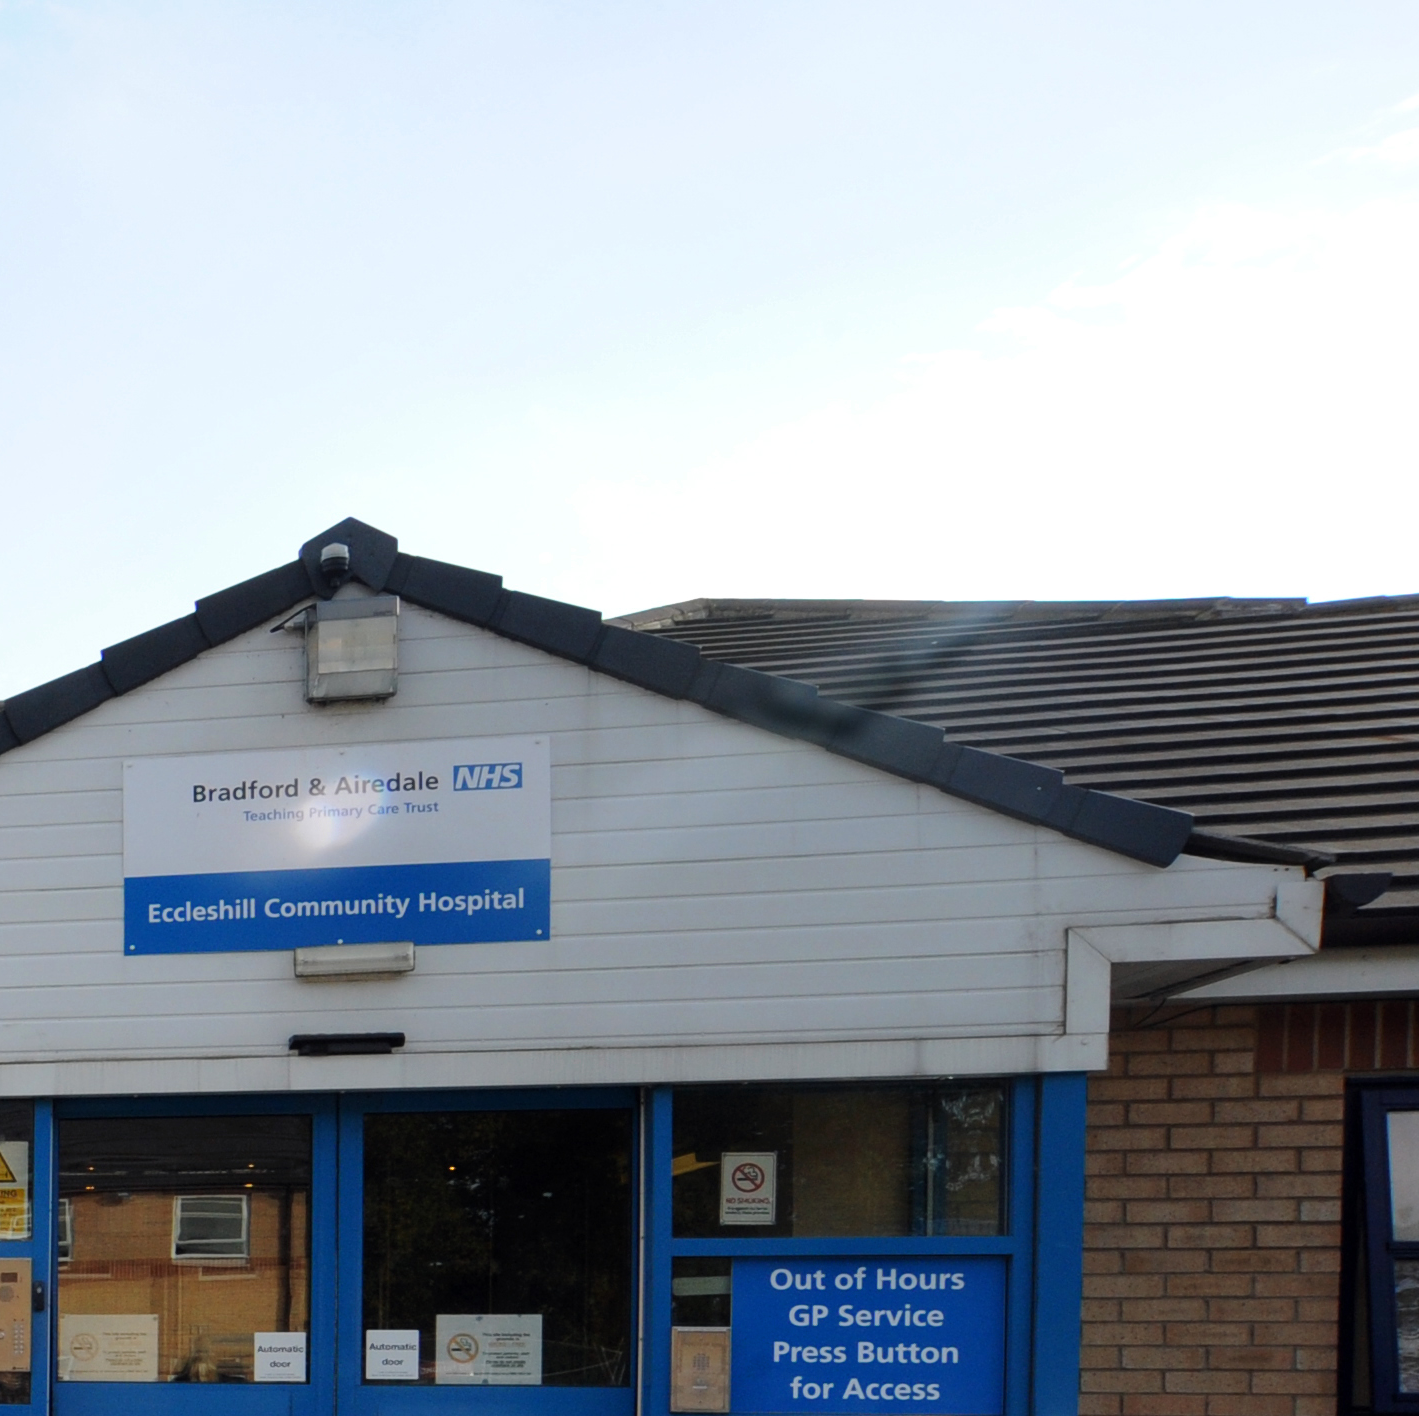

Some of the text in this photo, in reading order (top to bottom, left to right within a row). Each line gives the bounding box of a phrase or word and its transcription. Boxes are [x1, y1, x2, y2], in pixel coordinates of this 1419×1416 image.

[193, 771, 439, 803] Bradford & Airedale
[454, 764, 521, 790] NHS
[243, 801, 439, 823] Teaching Primary Care Trust
[148, 887, 525, 923] Eccleshill Community Hospital
[770, 1267, 965, 1291] Out of Hours
[788, 1303, 945, 1327] GP Service
[257, 1345, 304, 1353] Automatic
[368, 1342, 417, 1351] Automatic
[773, 1341, 959, 1363] Press Button
[269, 1360, 291, 1368] door
[381, 1357, 404, 1366] door
[789, 1376, 941, 1401] for Access
